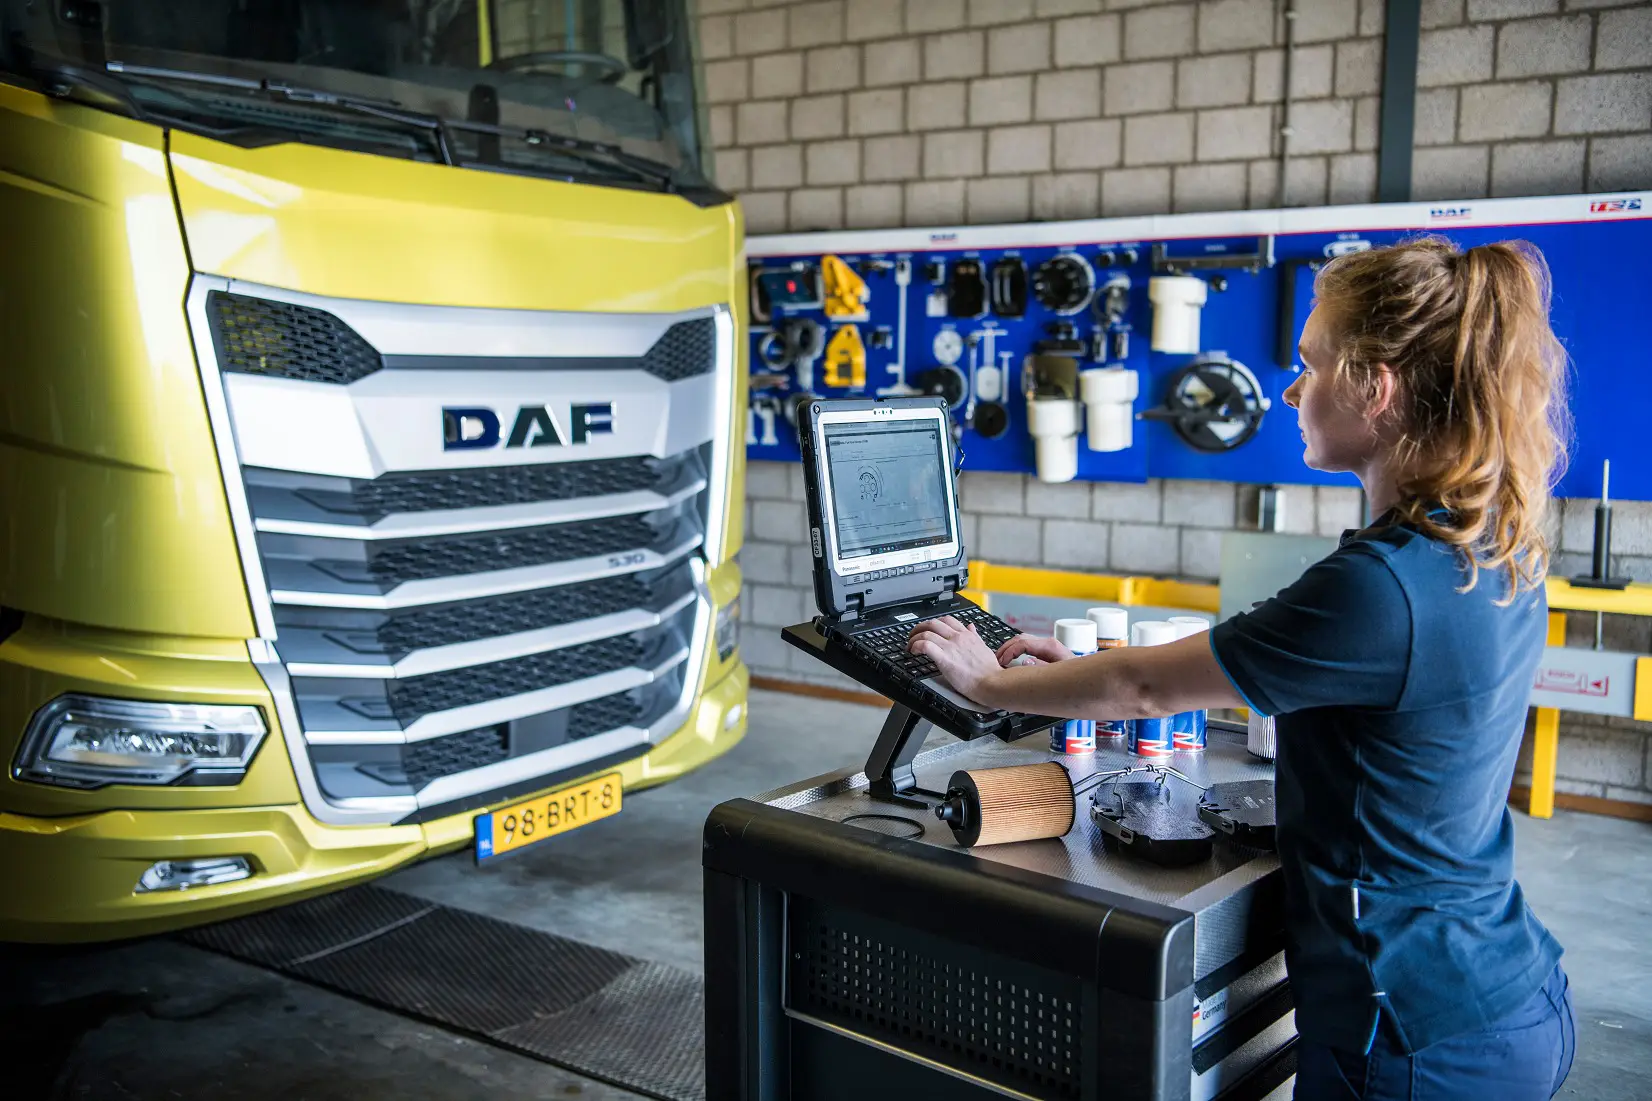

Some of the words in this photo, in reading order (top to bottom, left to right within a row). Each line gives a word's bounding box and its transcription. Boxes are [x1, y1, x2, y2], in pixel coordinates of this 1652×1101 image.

[1430, 208, 1471, 217] DAF
[442, 401, 616, 452] DAF
[842, 564, 861, 572] Panasonic
[503, 783, 613, 844] 98-BRT-8
[1202, 1000, 1227, 1020] Germany
